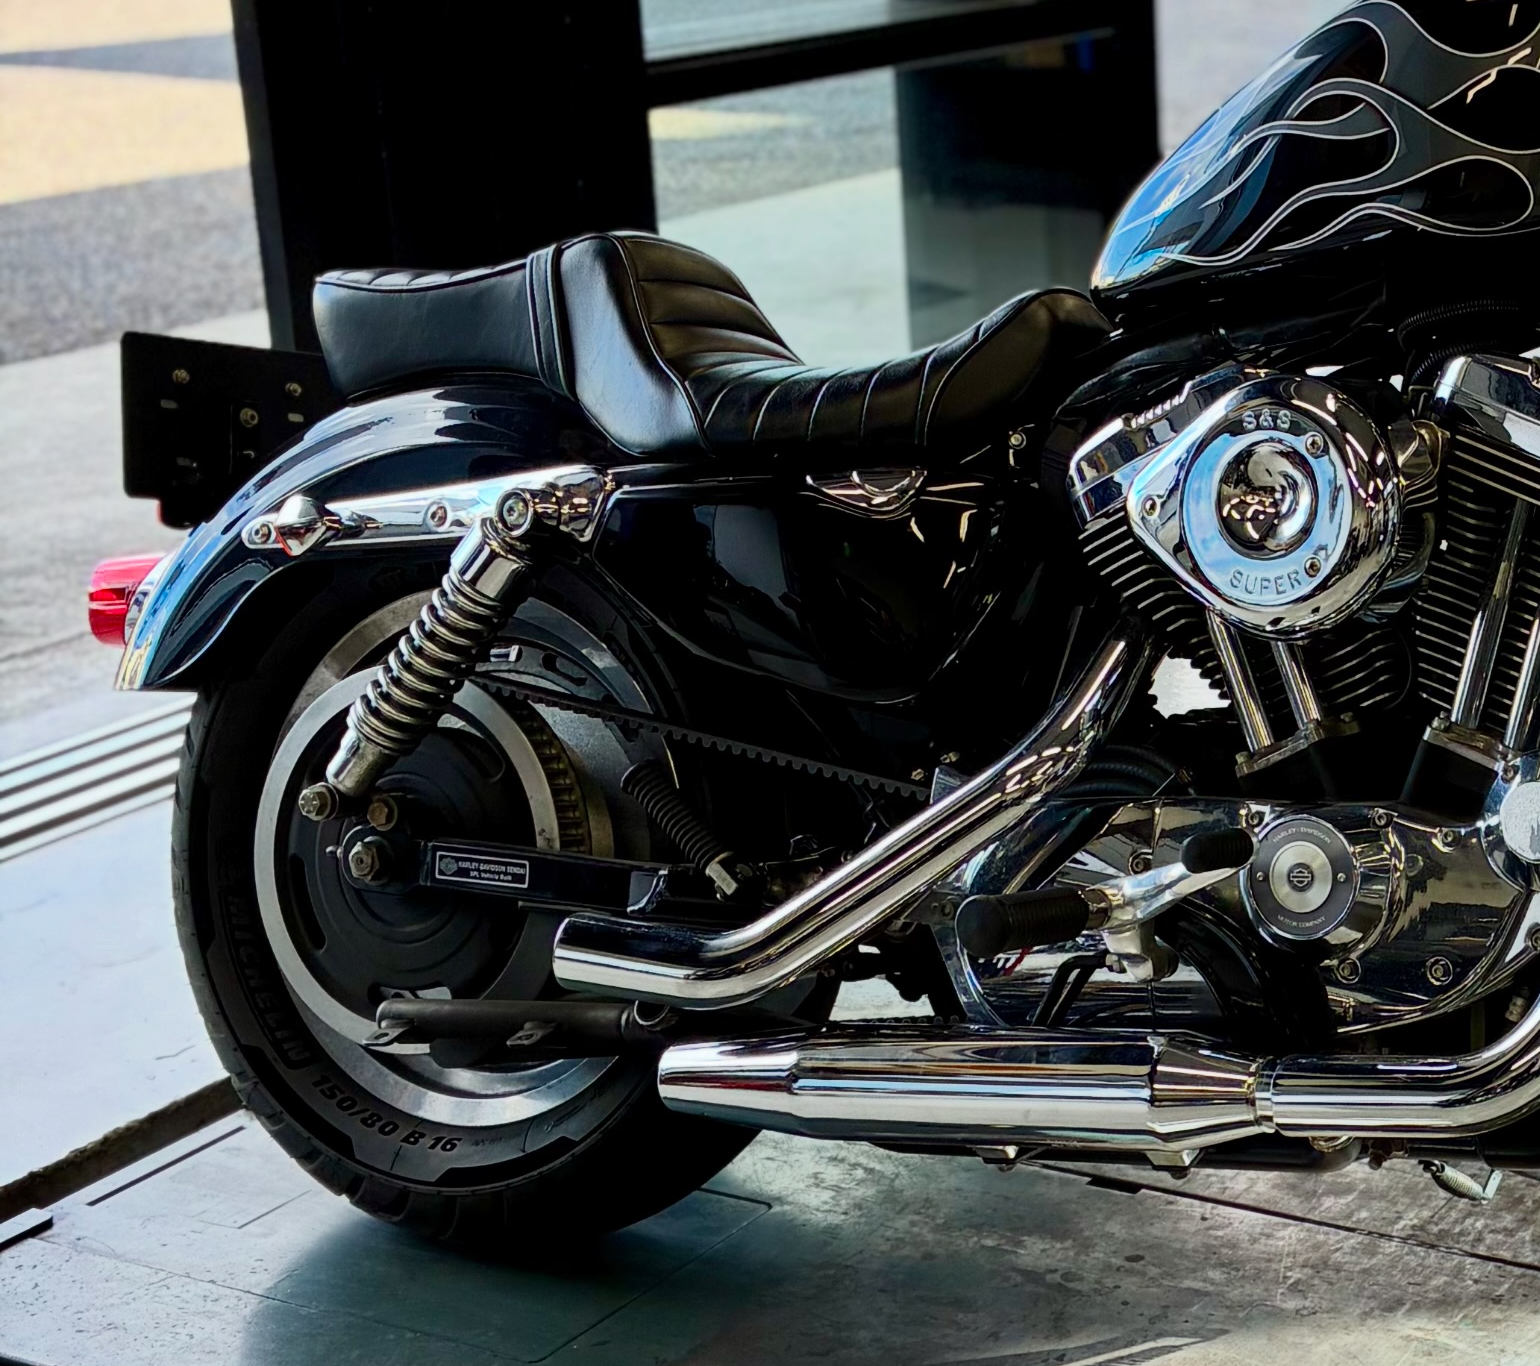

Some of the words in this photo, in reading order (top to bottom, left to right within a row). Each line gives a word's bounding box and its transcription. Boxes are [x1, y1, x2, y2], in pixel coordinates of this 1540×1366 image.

[1241, 408, 1292, 431] S&S
[1229, 568, 1302, 596] SUPER
[312, 1074, 399, 1136] 150/80
[400, 1129, 427, 1146] B
[427, 1136, 463, 1152] 16
